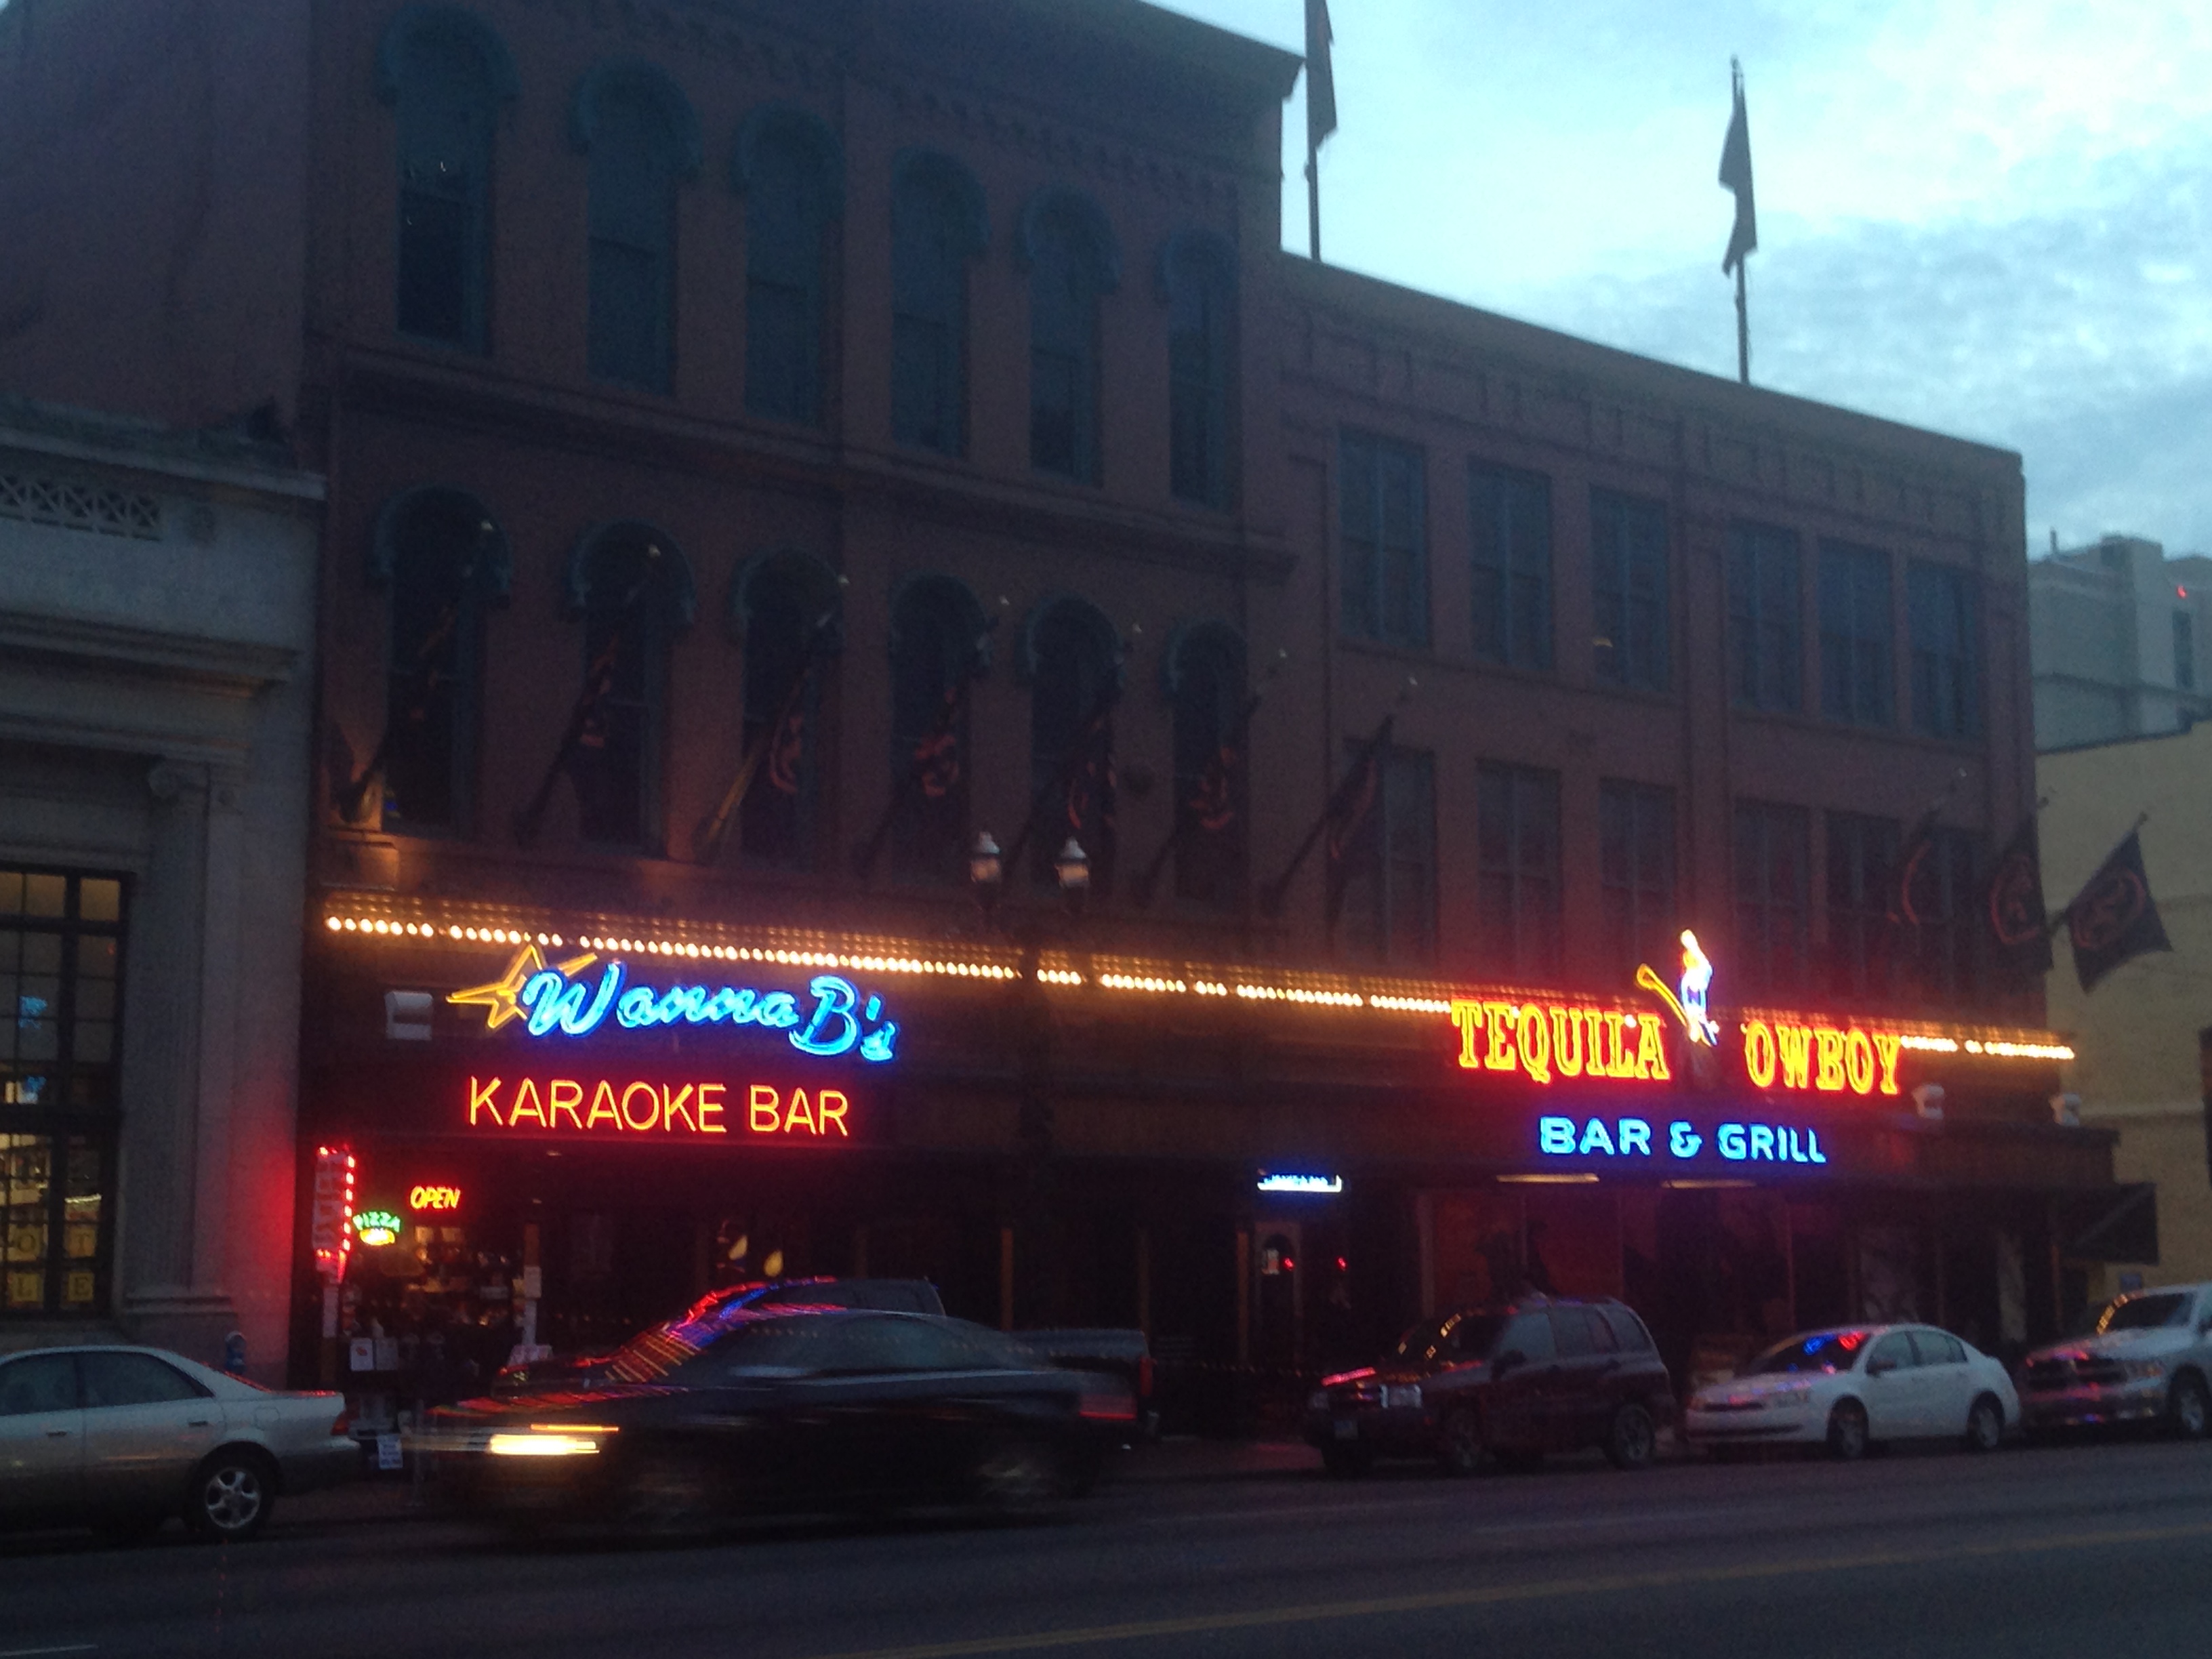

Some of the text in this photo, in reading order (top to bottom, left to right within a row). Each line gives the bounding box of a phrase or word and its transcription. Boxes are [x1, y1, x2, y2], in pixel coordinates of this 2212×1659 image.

[520, 962, 896, 1061] Wanna B's
[1451, 998, 1671, 1084] TEQUILA
[469, 1075, 848, 1136] KARAOKE BAR
[1539, 1115, 1826, 1164] BAR & GRILL
[352, 1211, 401, 1233] PIZZA
[409, 1185, 462, 1210] OPEN
